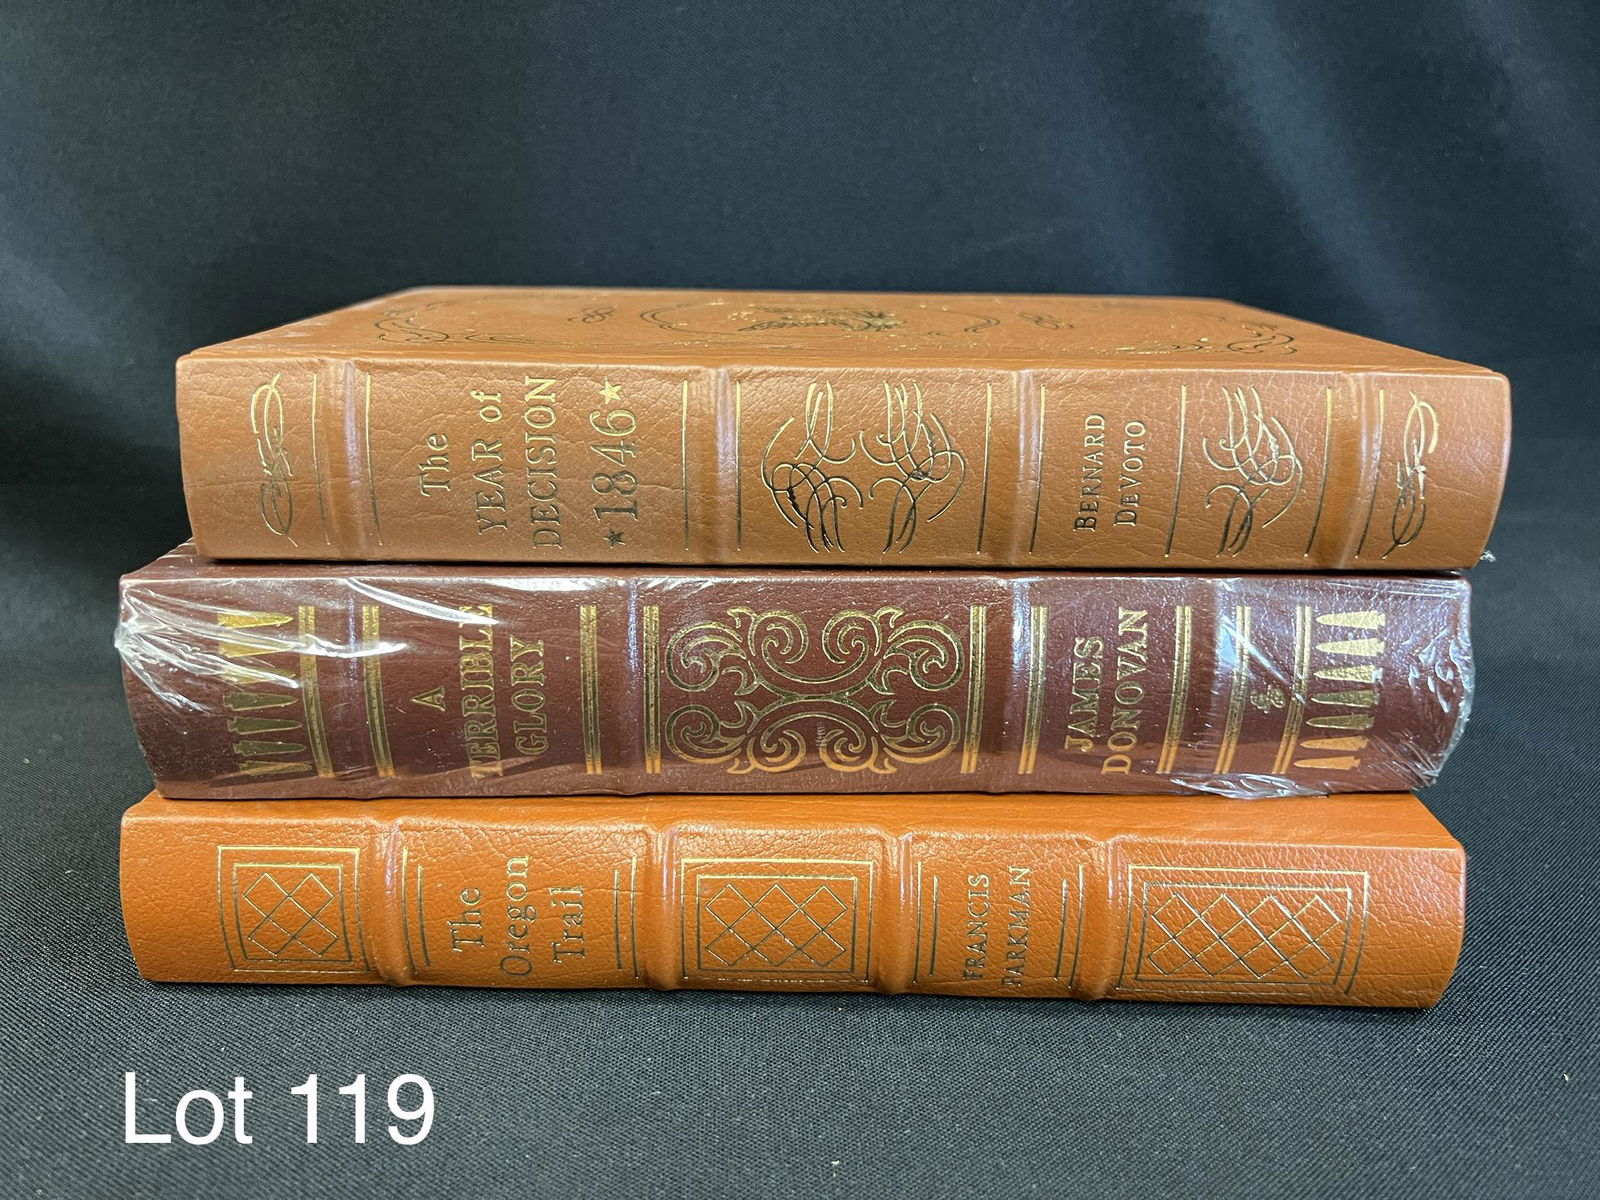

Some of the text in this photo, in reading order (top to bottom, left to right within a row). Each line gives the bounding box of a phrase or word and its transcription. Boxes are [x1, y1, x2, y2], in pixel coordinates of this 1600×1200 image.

[417, 431, 451, 498] The
[470, 388, 508, 535] YEAR of
[524, 375, 563, 549] DECISION
[589, 408, 639, 521] 1846
[1072, 412, 1106, 533] BERNARD
[410, 685, 447, 712] A
[509, 633, 550, 756] GLORY
[1064, 636, 1105, 752] JAMES
[1100, 605, 1149, 776] DONOVAN
[446, 886, 486, 953] The
[499, 854, 538, 977] Oregon
[548, 884, 586, 964] Trail
[962, 871, 991, 981] FRANCIS
[1000, 864, 1032, 987] PARKMAN
